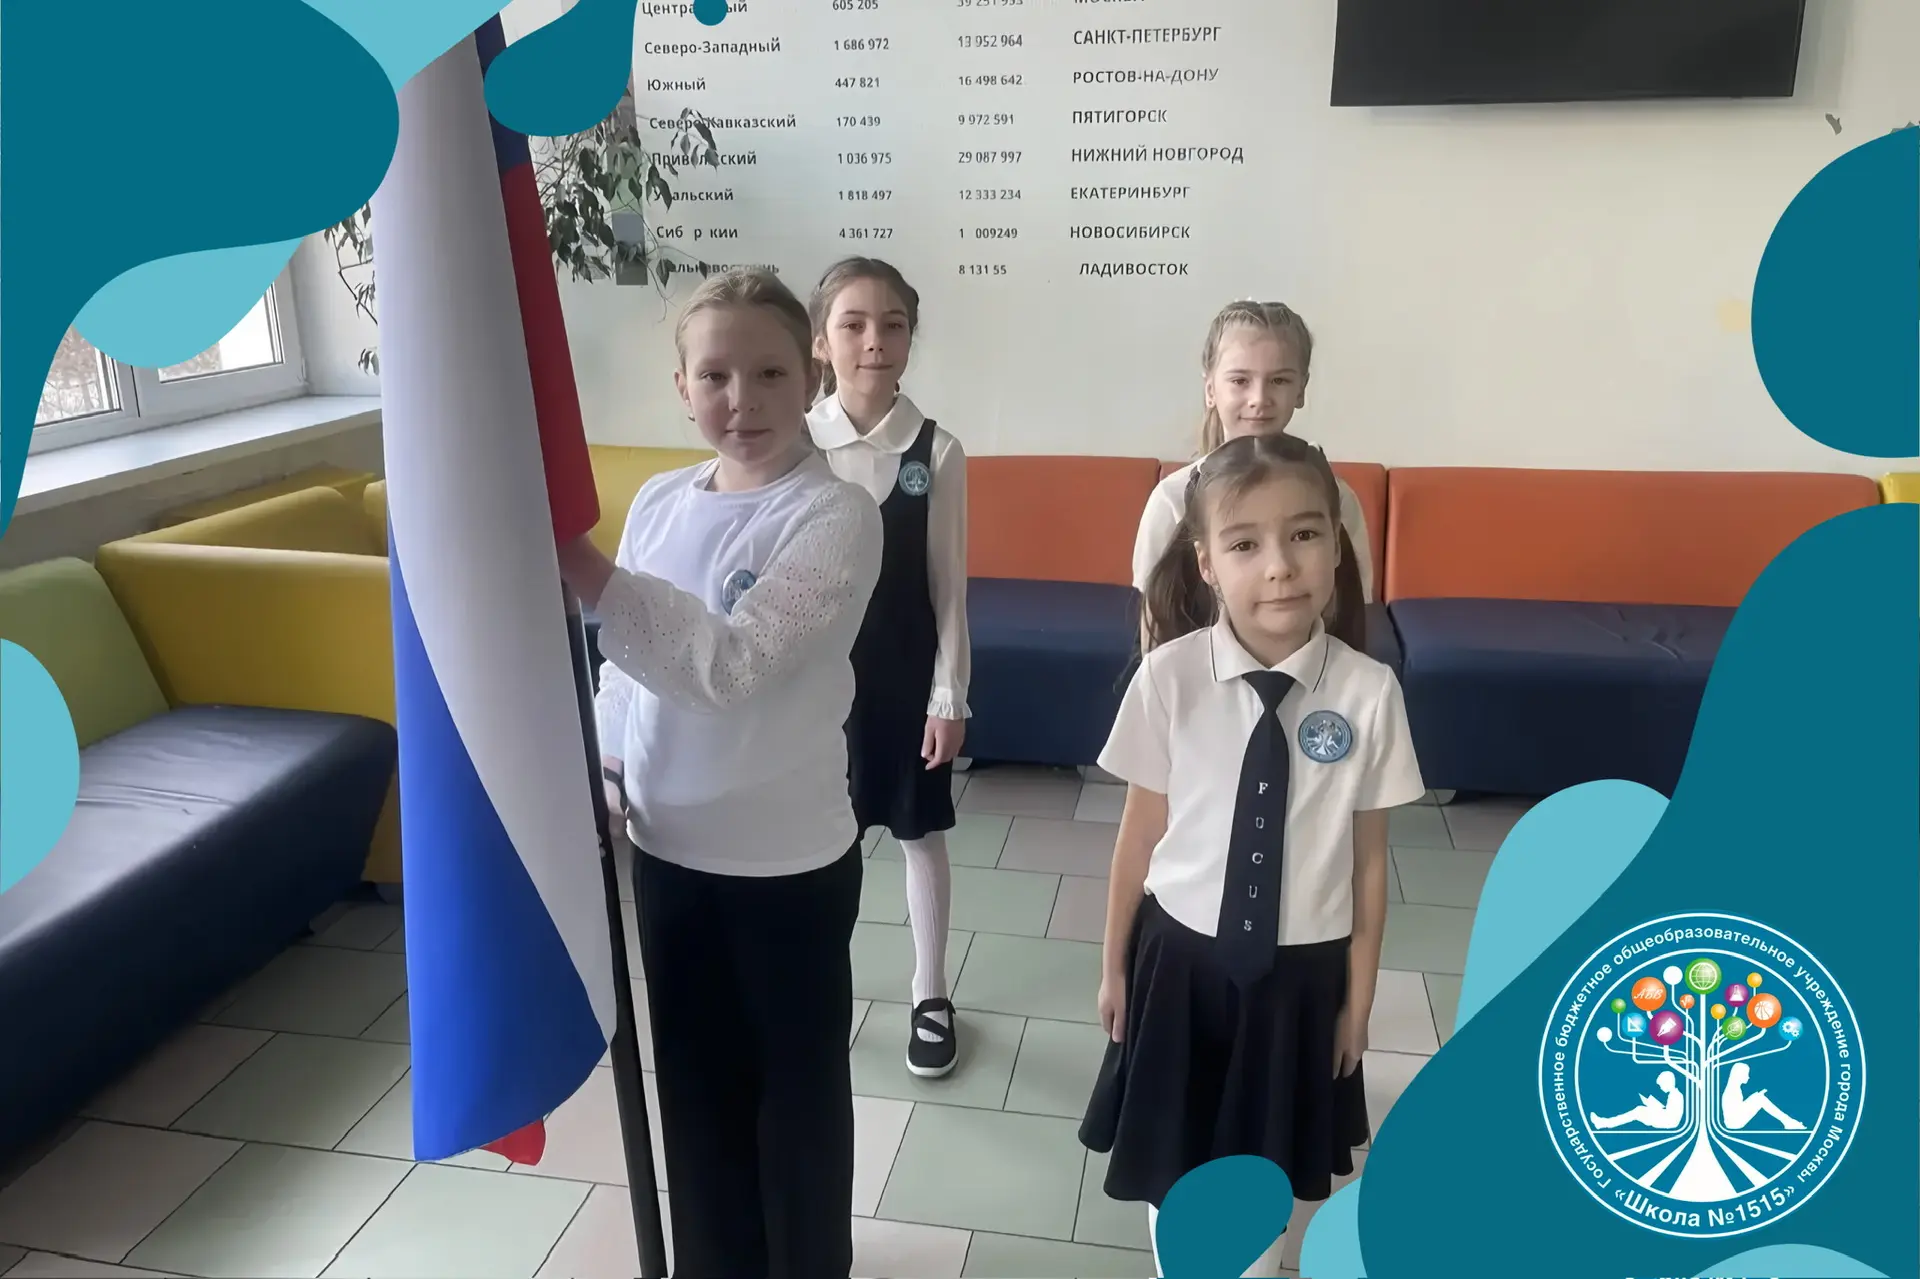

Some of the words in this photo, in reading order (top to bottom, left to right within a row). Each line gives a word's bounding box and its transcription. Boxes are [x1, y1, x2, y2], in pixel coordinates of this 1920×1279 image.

[957, 36, 972, 48] 13
[975, 35, 998, 48] 952
[1000, 34, 1023, 48] 964
[1073, 26, 1223, 45] САНКТ-ПЕТЕРБУРГ
[644, 37, 781, 57] Северо-Западный
[843, 39, 865, 51] 686
[867, 38, 890, 51] 972
[834, 78, 856, 89] 447
[859, 77, 880, 89] 821
[958, 76, 973, 86] 16
[974, 76, 997, 86] 498
[1000, 75, 1023, 86] 642
[1073, 68, 1219, 85] РОСТОВ-НА-ДОНУ
[647, 77, 706, 91] Южный
[649, 114, 797, 133] СевероКавказский
[836, 116, 857, 128] 170
[859, 116, 881, 127] 439
[968, 114, 991, 126] 972
[993, 114, 1014, 126] 591
[1072, 110, 1168, 124] ПЯТИГОРСК
[652, 151, 757, 168] Привлский
[846, 153, 868, 165] 036
[870, 152, 892, 165] 975
[958, 152, 973, 164] 29
[975, 152, 997, 164] 087
[1000, 151, 1022, 164] 997
[1071, 145, 1148, 162] НИЖНИЙ
[1152, 147, 1244, 164] НОВГОРОД
[653, 188, 734, 201] Уальский
[847, 190, 869, 201] 818
[871, 190, 893, 201] 497
[959, 190, 973, 200] 12
[975, 190, 997, 201] 333
[1000, 190, 1022, 200] 234
[1071, 186, 1191, 199] ЕКАТЕРИНБУРГ
[848, 228, 869, 239] 361
[872, 228, 894, 239] 727
[975, 228, 1018, 239] 009249
[1070, 226, 1191, 239] НОВОСИБИРСК
[969, 265, 989, 276] 131
[993, 265, 1007, 276] 55
[1079, 263, 1189, 278] ЛАДИВОСТОК
